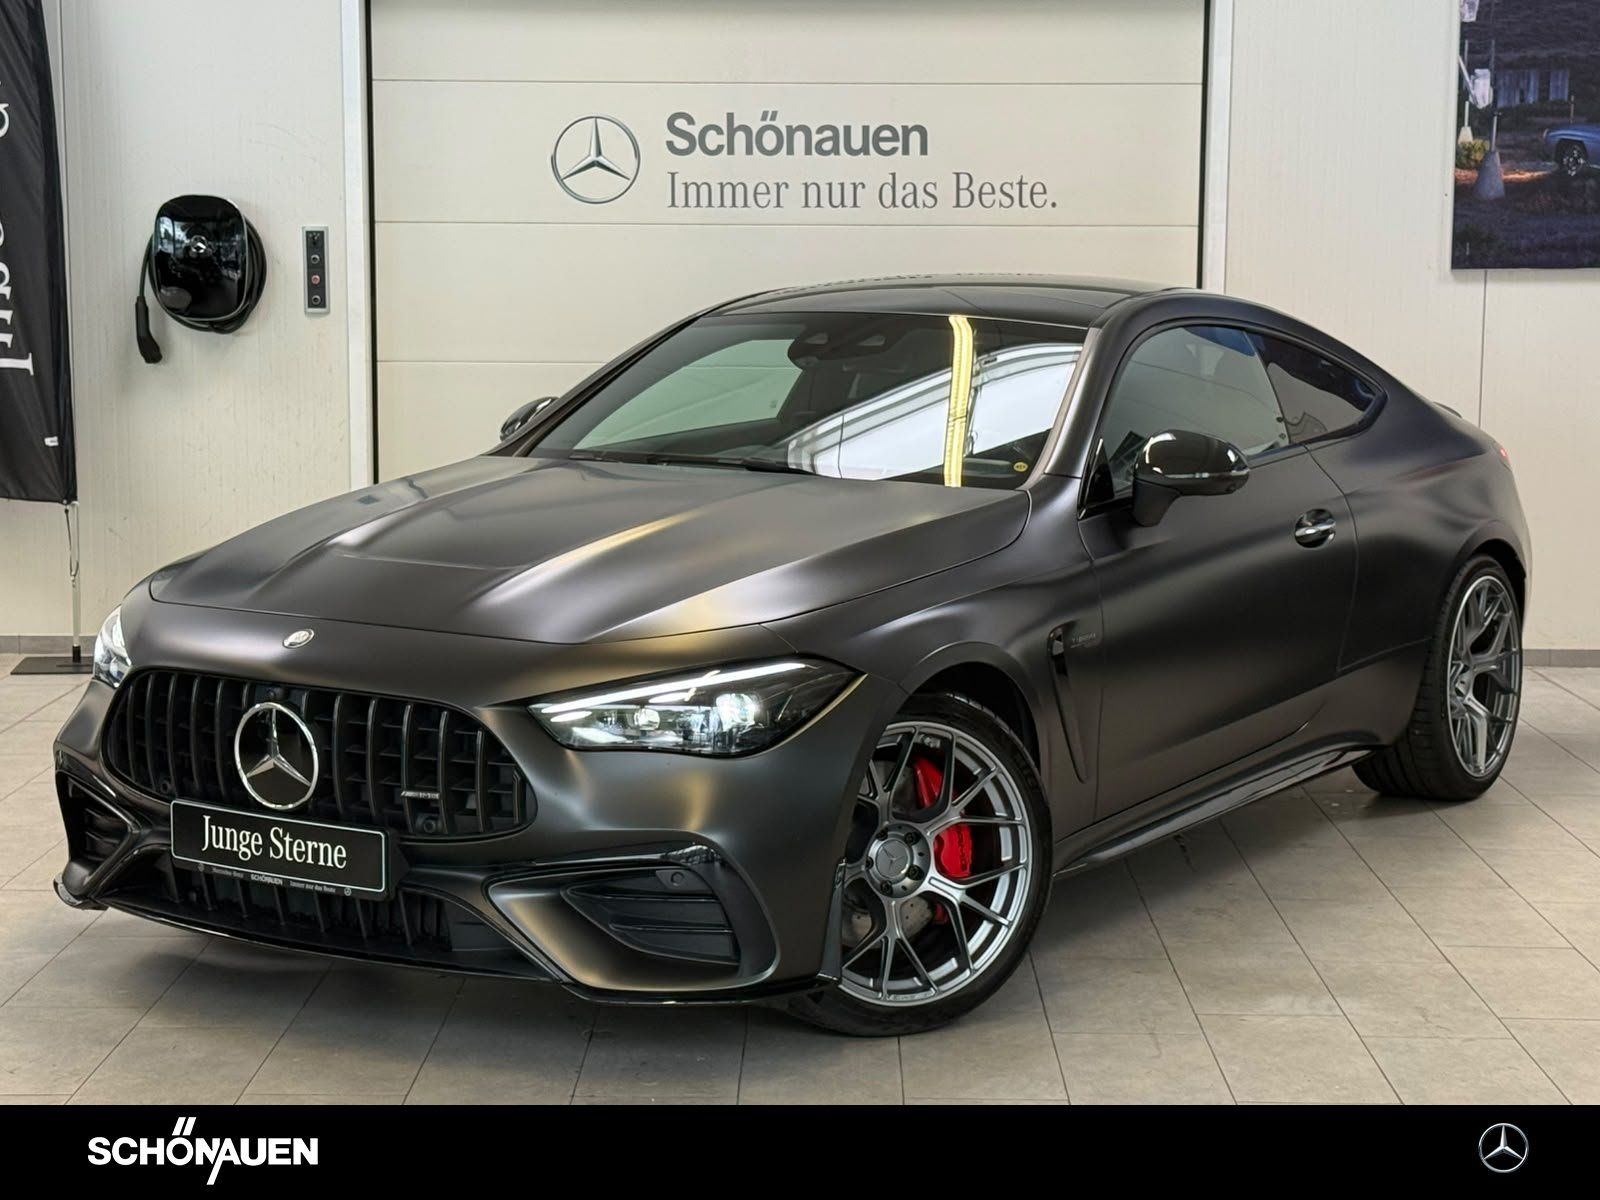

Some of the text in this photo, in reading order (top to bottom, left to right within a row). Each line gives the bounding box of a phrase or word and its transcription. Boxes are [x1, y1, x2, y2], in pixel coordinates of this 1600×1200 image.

[665, 110, 929, 157] Schönauen
[666, 171, 1058, 209] Immer nur das Beste.
[201, 814, 348, 870] Junge Sterne
